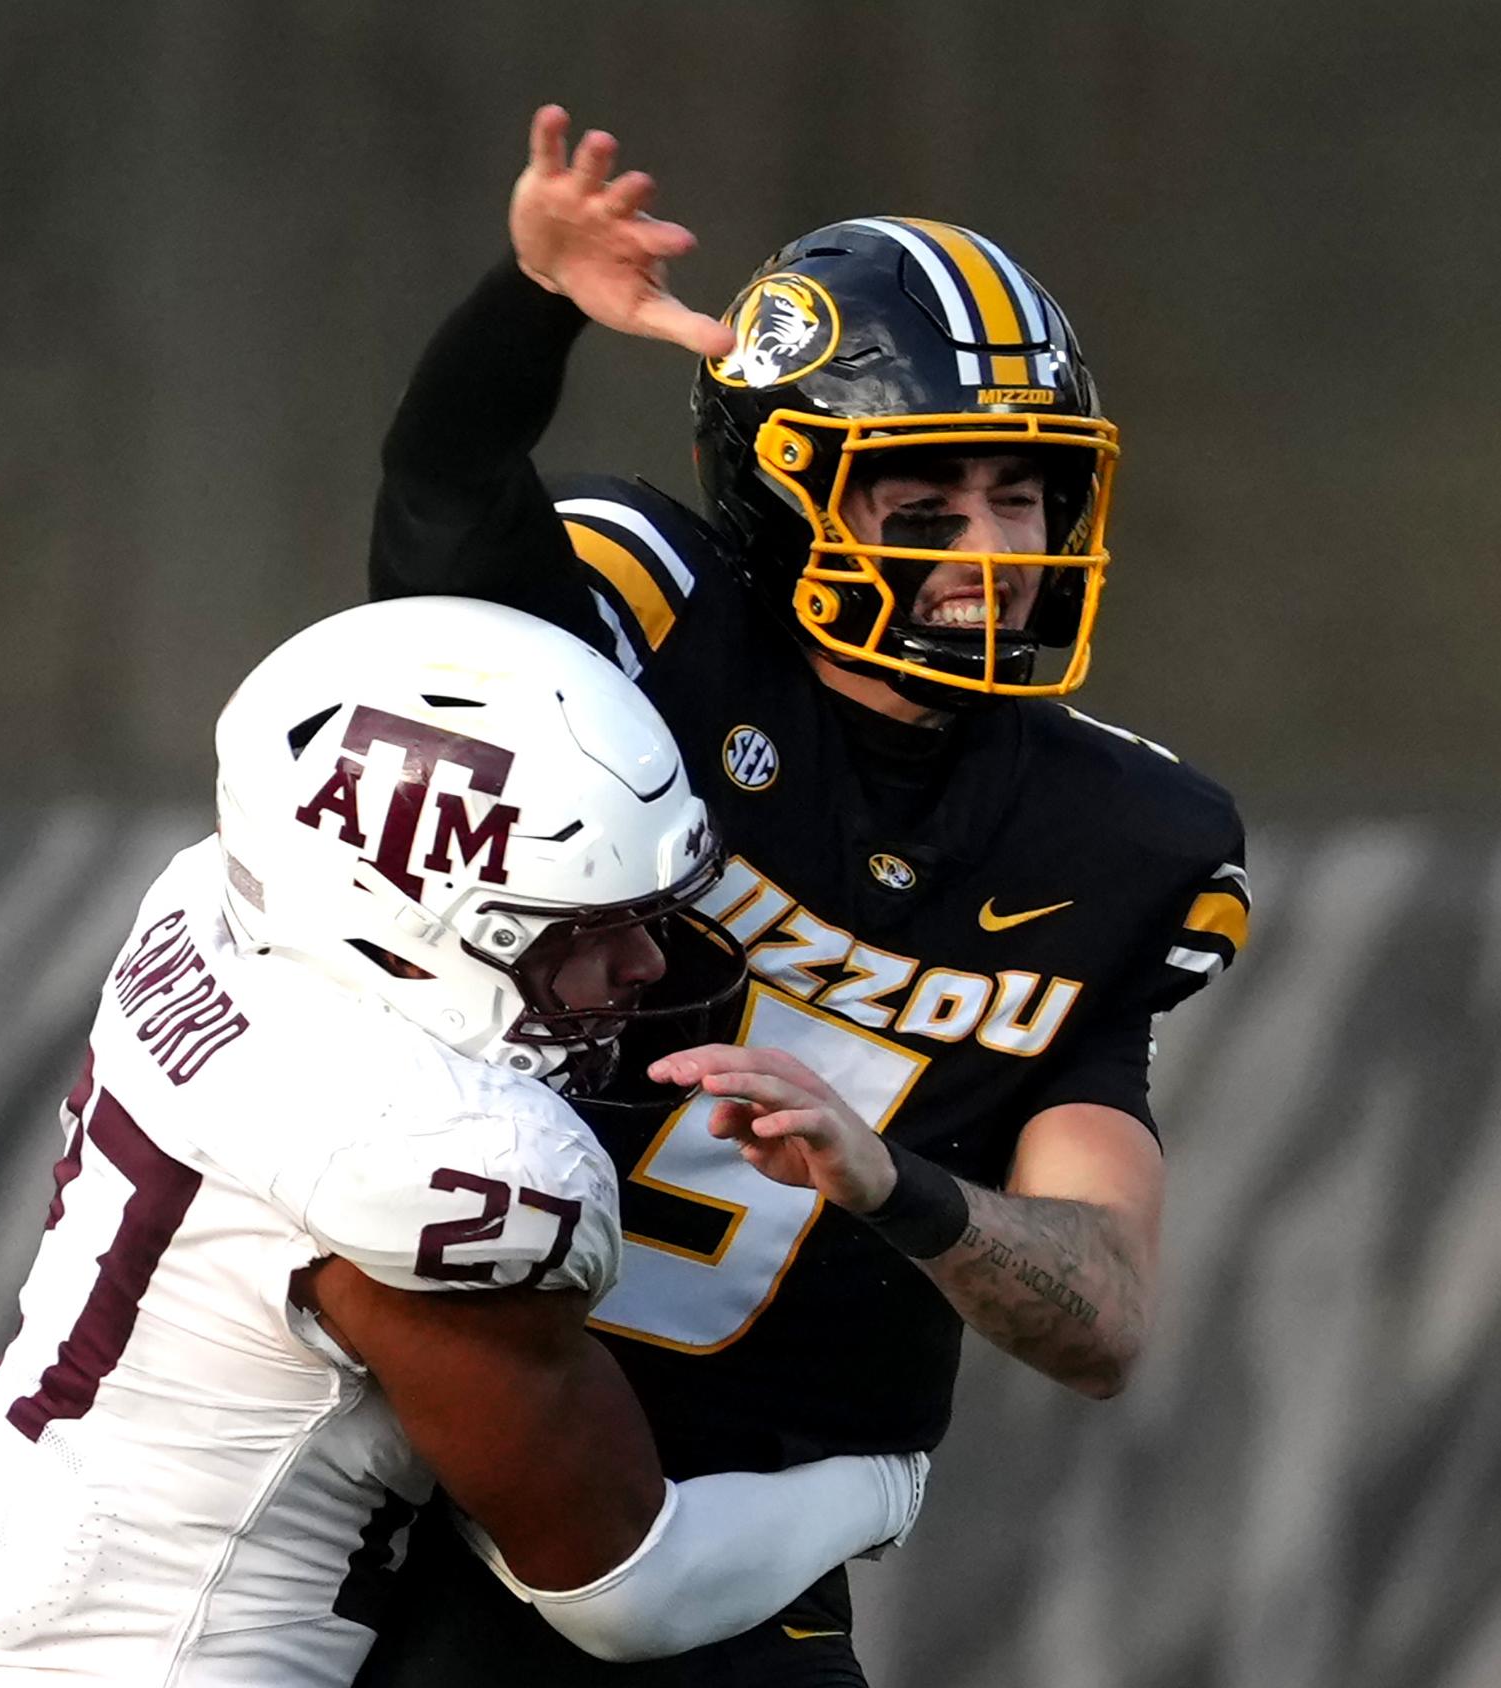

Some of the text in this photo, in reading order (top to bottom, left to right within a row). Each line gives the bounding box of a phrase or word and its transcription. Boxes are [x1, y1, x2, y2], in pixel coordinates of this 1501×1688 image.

[977, 388, 1055, 406] MIZZOU
[725, 727, 777, 788] SEC
[114, 908, 251, 1087] SANFORD
[414, 1166, 582, 1285] 27
